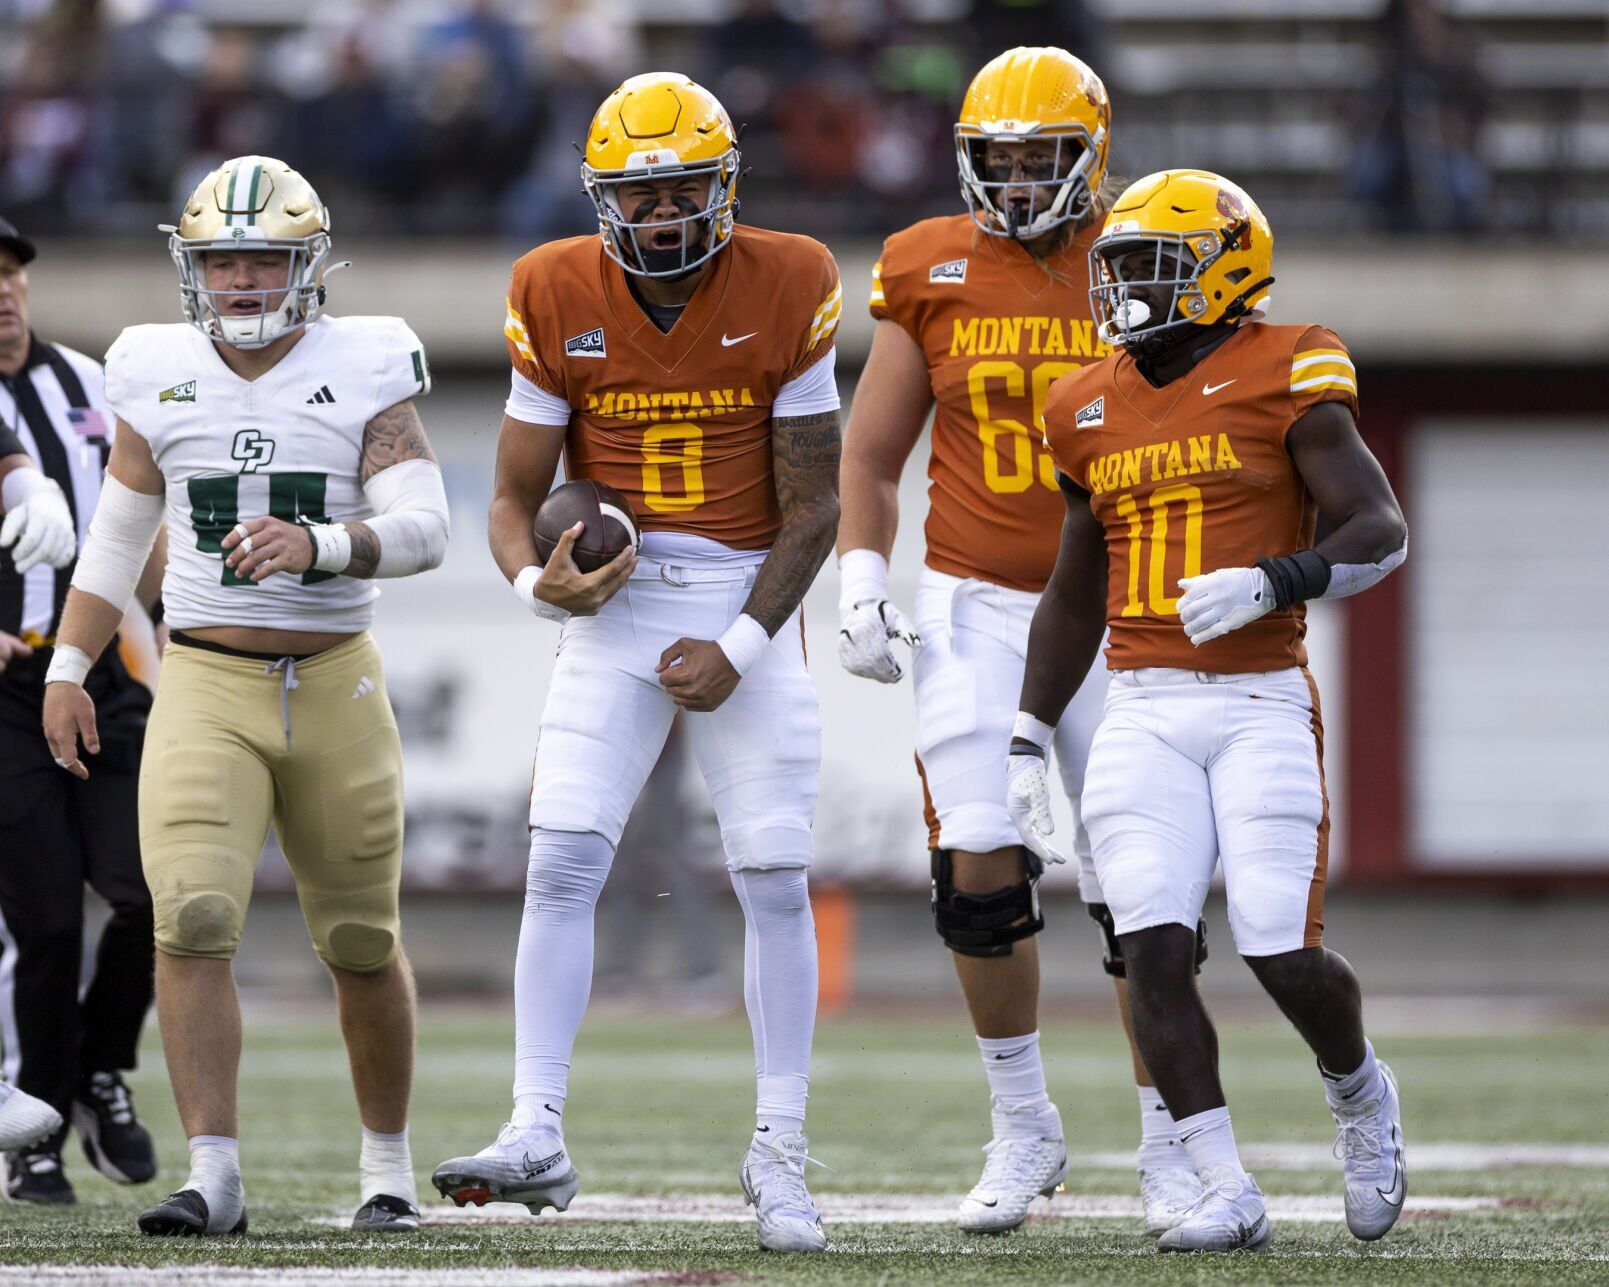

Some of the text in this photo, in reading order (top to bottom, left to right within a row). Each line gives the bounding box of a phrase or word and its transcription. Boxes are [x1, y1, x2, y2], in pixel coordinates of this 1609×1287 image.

[585, 387, 755, 422] MONTANA
[640, 421, 706, 512] 8
[1089, 432, 1243, 495] MONTANA
[1116, 482, 1204, 618] 10
